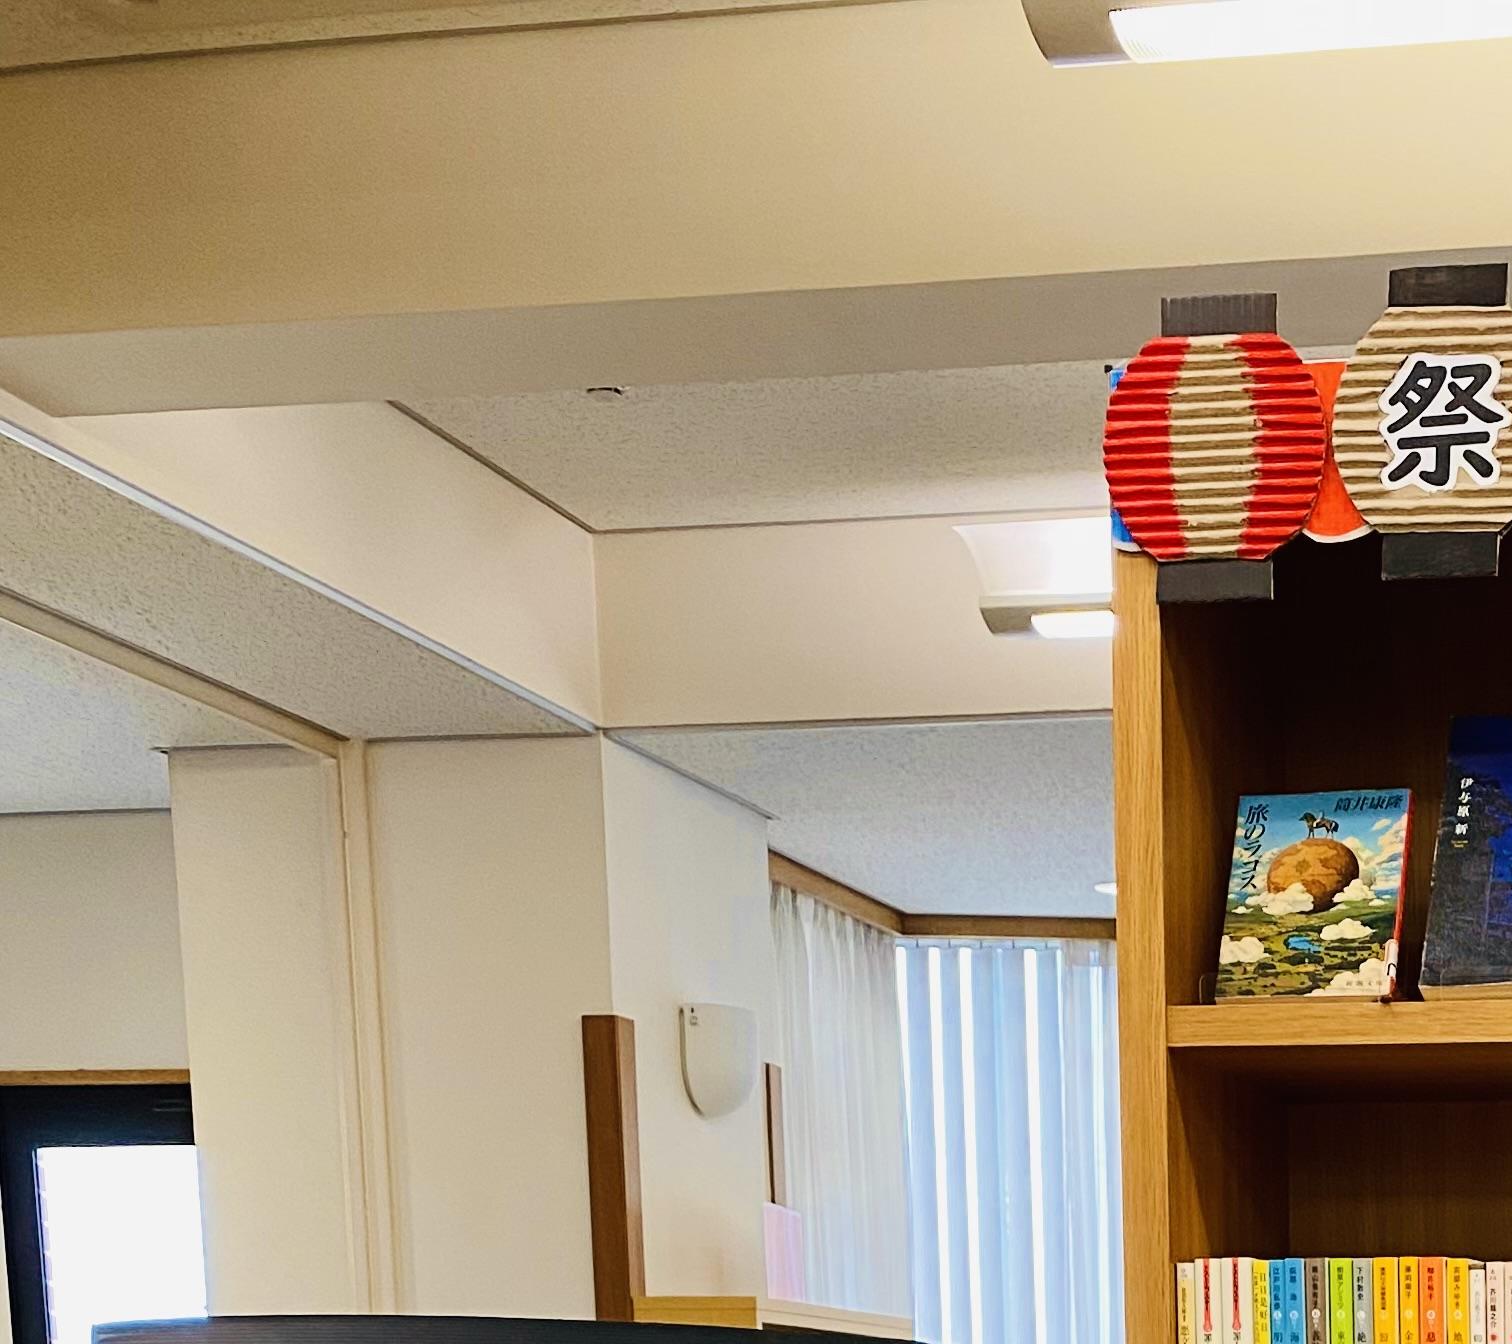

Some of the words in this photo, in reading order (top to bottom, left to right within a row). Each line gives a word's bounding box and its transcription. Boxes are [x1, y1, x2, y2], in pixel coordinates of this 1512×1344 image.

[1387, 359, 1505, 486] 祭
[1240, 803, 1268, 892] 旅のラゴス
